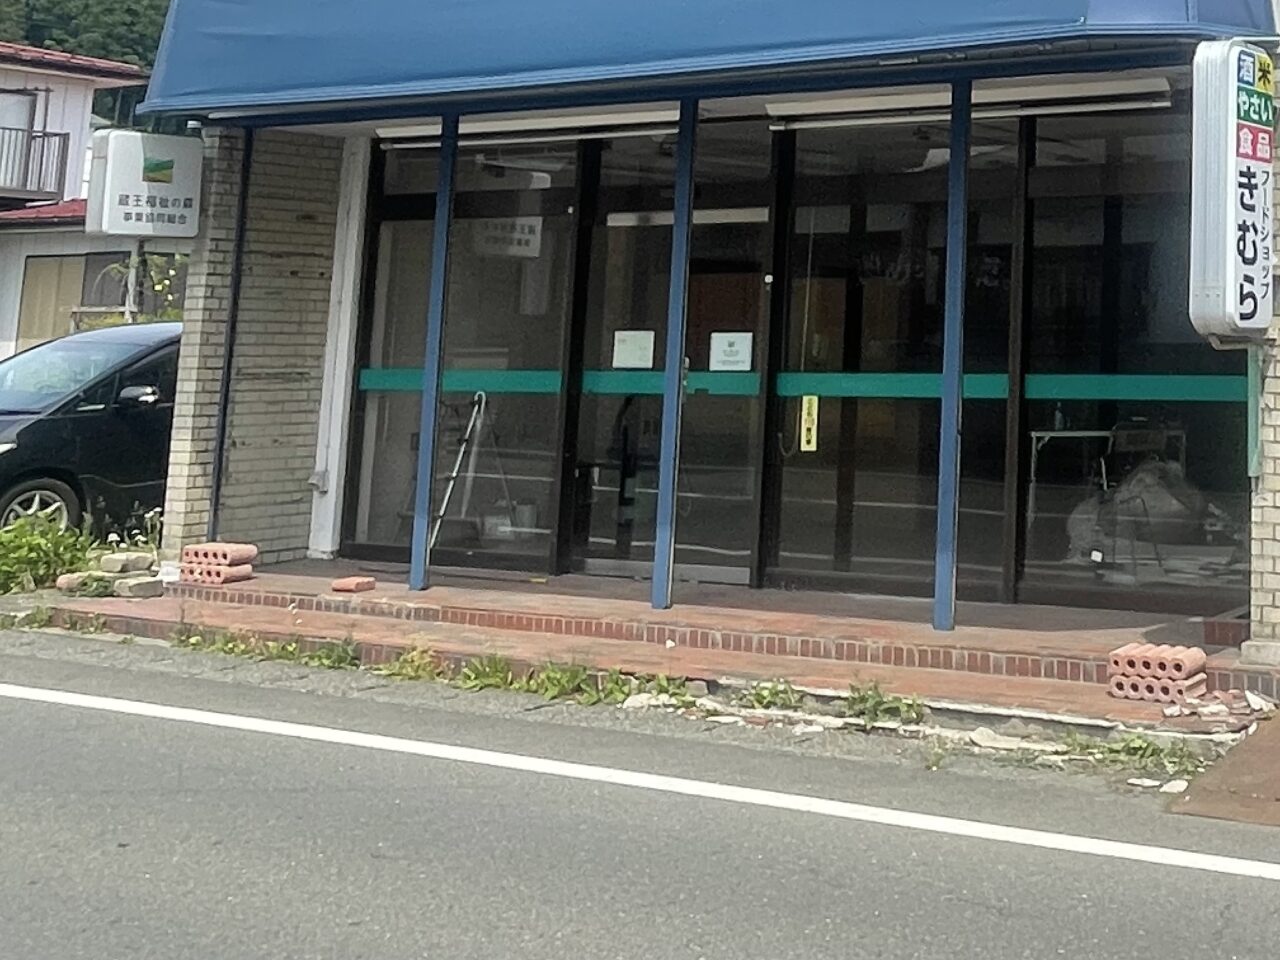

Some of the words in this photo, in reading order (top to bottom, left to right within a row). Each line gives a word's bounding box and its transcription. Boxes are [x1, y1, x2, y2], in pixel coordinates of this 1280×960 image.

[1239, 54, 1255, 84] 酒
[1257, 60, 1272, 90] 米
[1239, 90, 1273, 122] やさい
[1238, 127, 1270, 160] 食品
[1237, 165, 1259, 321] きむら
[1259, 169, 1271, 300] フードショップ
